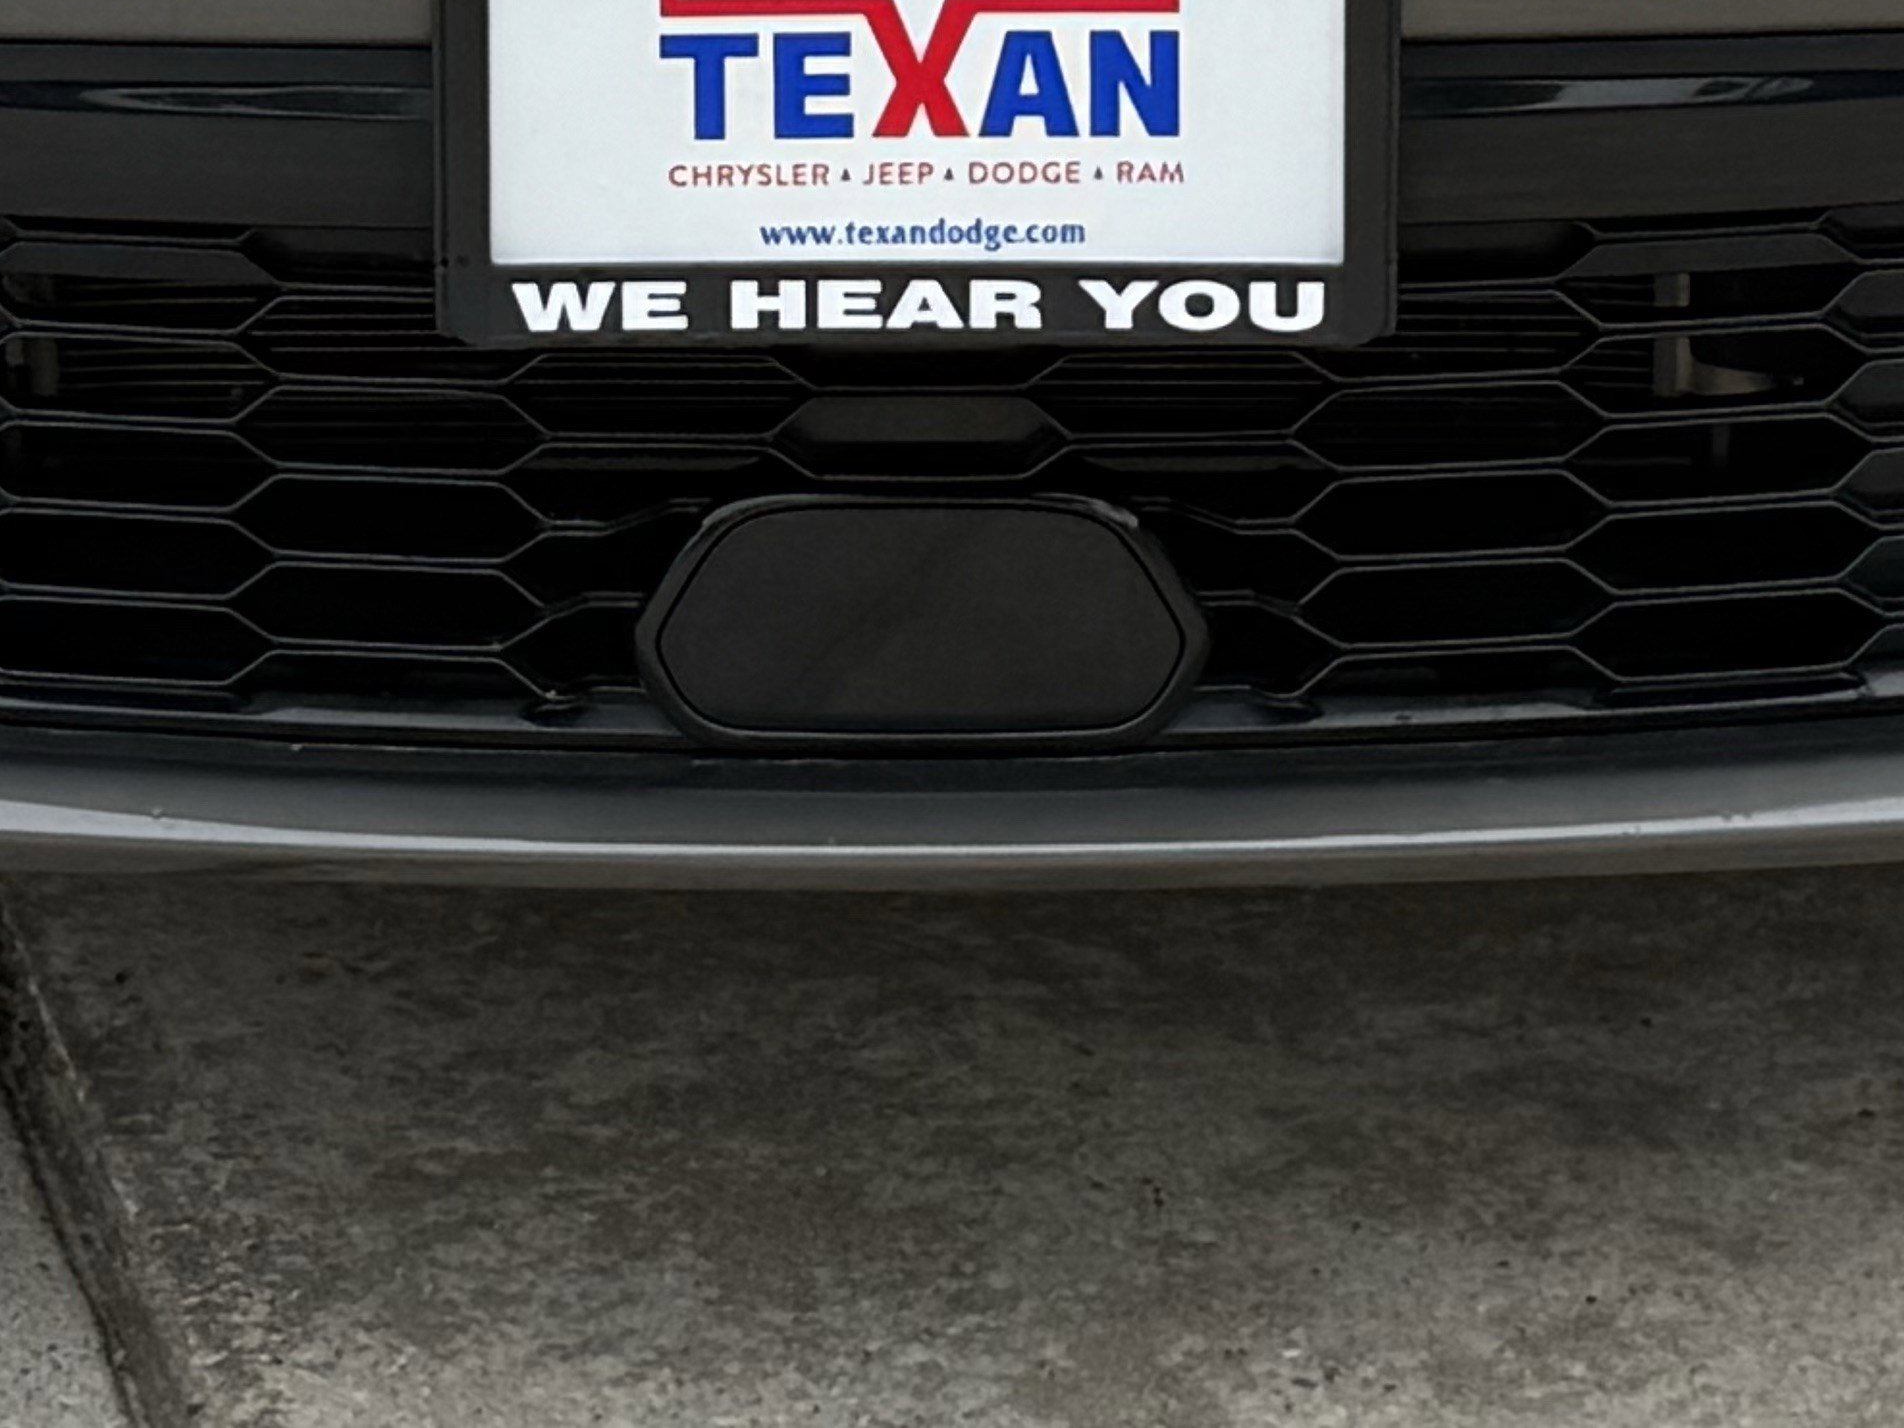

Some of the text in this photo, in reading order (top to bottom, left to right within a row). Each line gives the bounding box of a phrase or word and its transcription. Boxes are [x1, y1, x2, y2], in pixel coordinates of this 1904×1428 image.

[667, 160, 1185, 187] CHRYSLER JEEP DODGE RAM
[759, 217, 1087, 251] www.texandodge.com
[511, 279, 1326, 333] WE HEAR YOU
